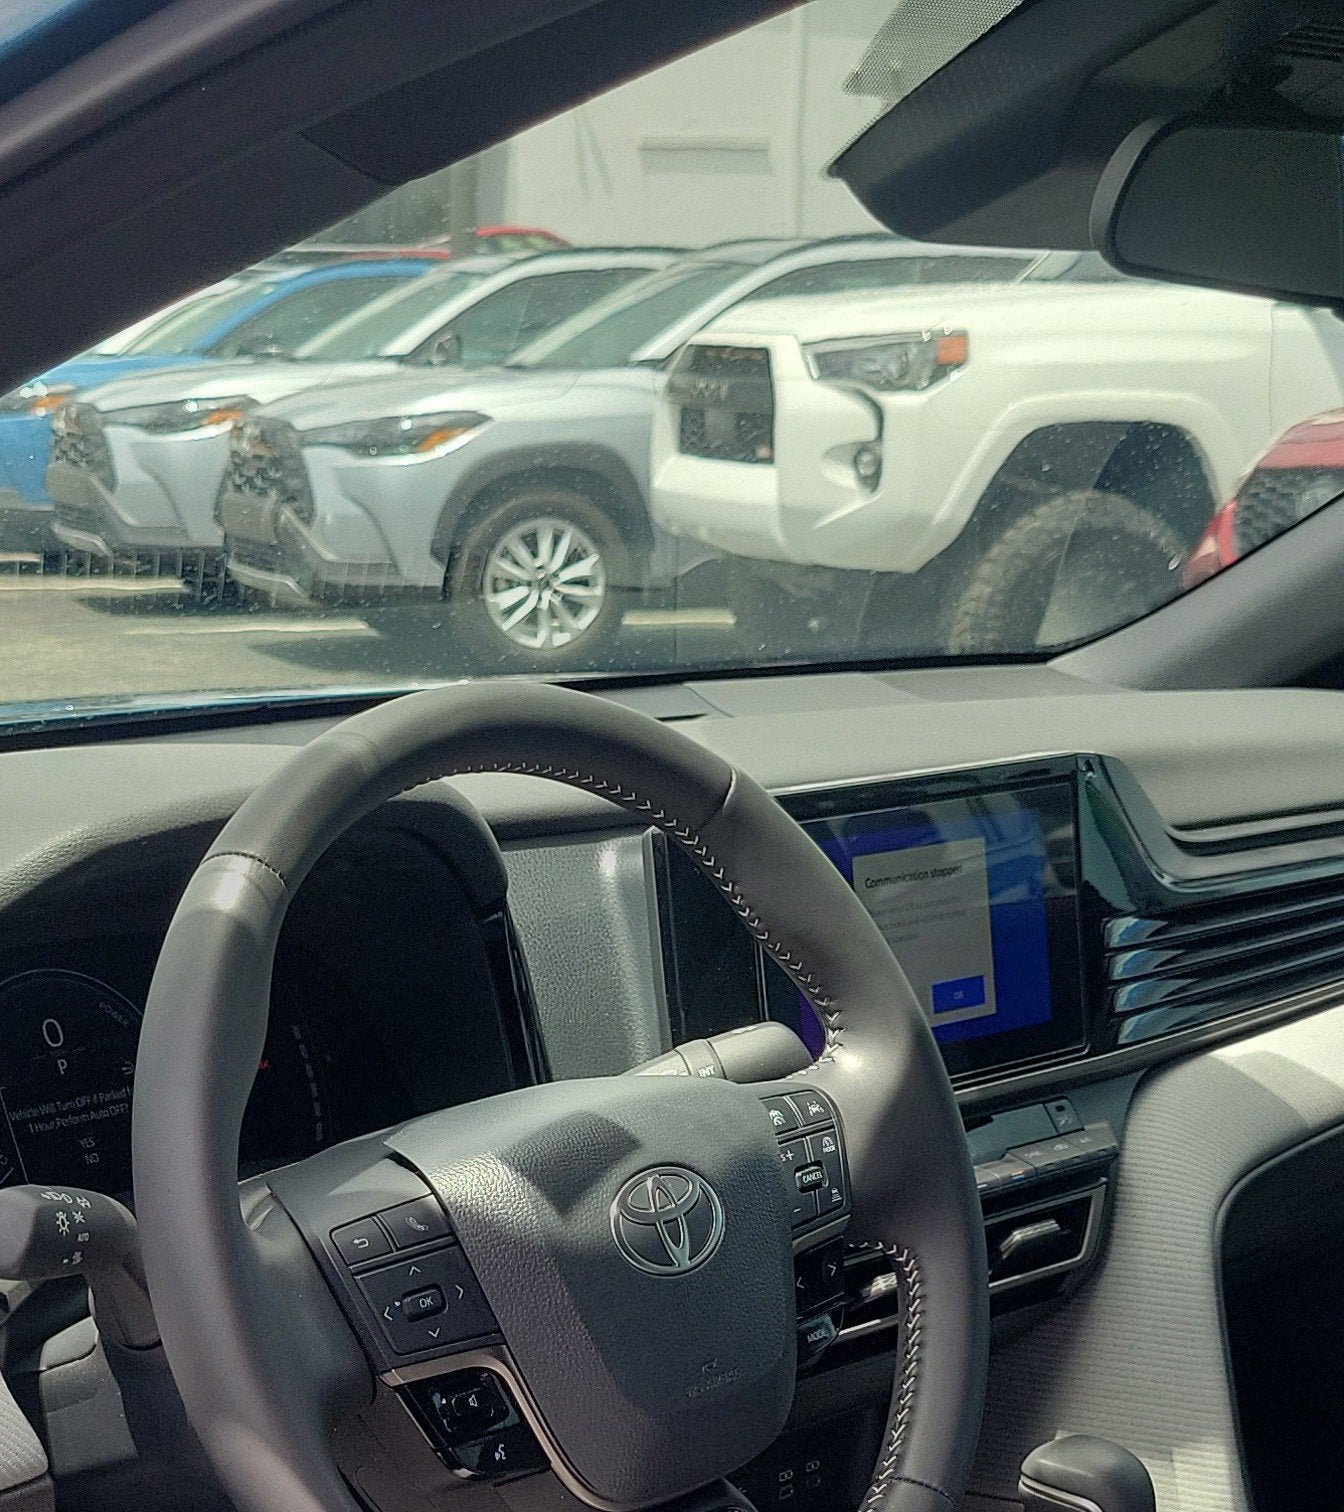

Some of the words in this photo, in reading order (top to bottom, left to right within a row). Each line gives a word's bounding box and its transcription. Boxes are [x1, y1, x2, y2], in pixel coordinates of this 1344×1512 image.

[41, 1018, 64, 1048] 0
[57, 1058, 68, 1075] P
[79, 1137, 96, 1149] YES
[84, 1153, 100, 1165] NO
[802, 1171, 823, 1183] CANCEL
[419, 1296, 434, 1308] OK
